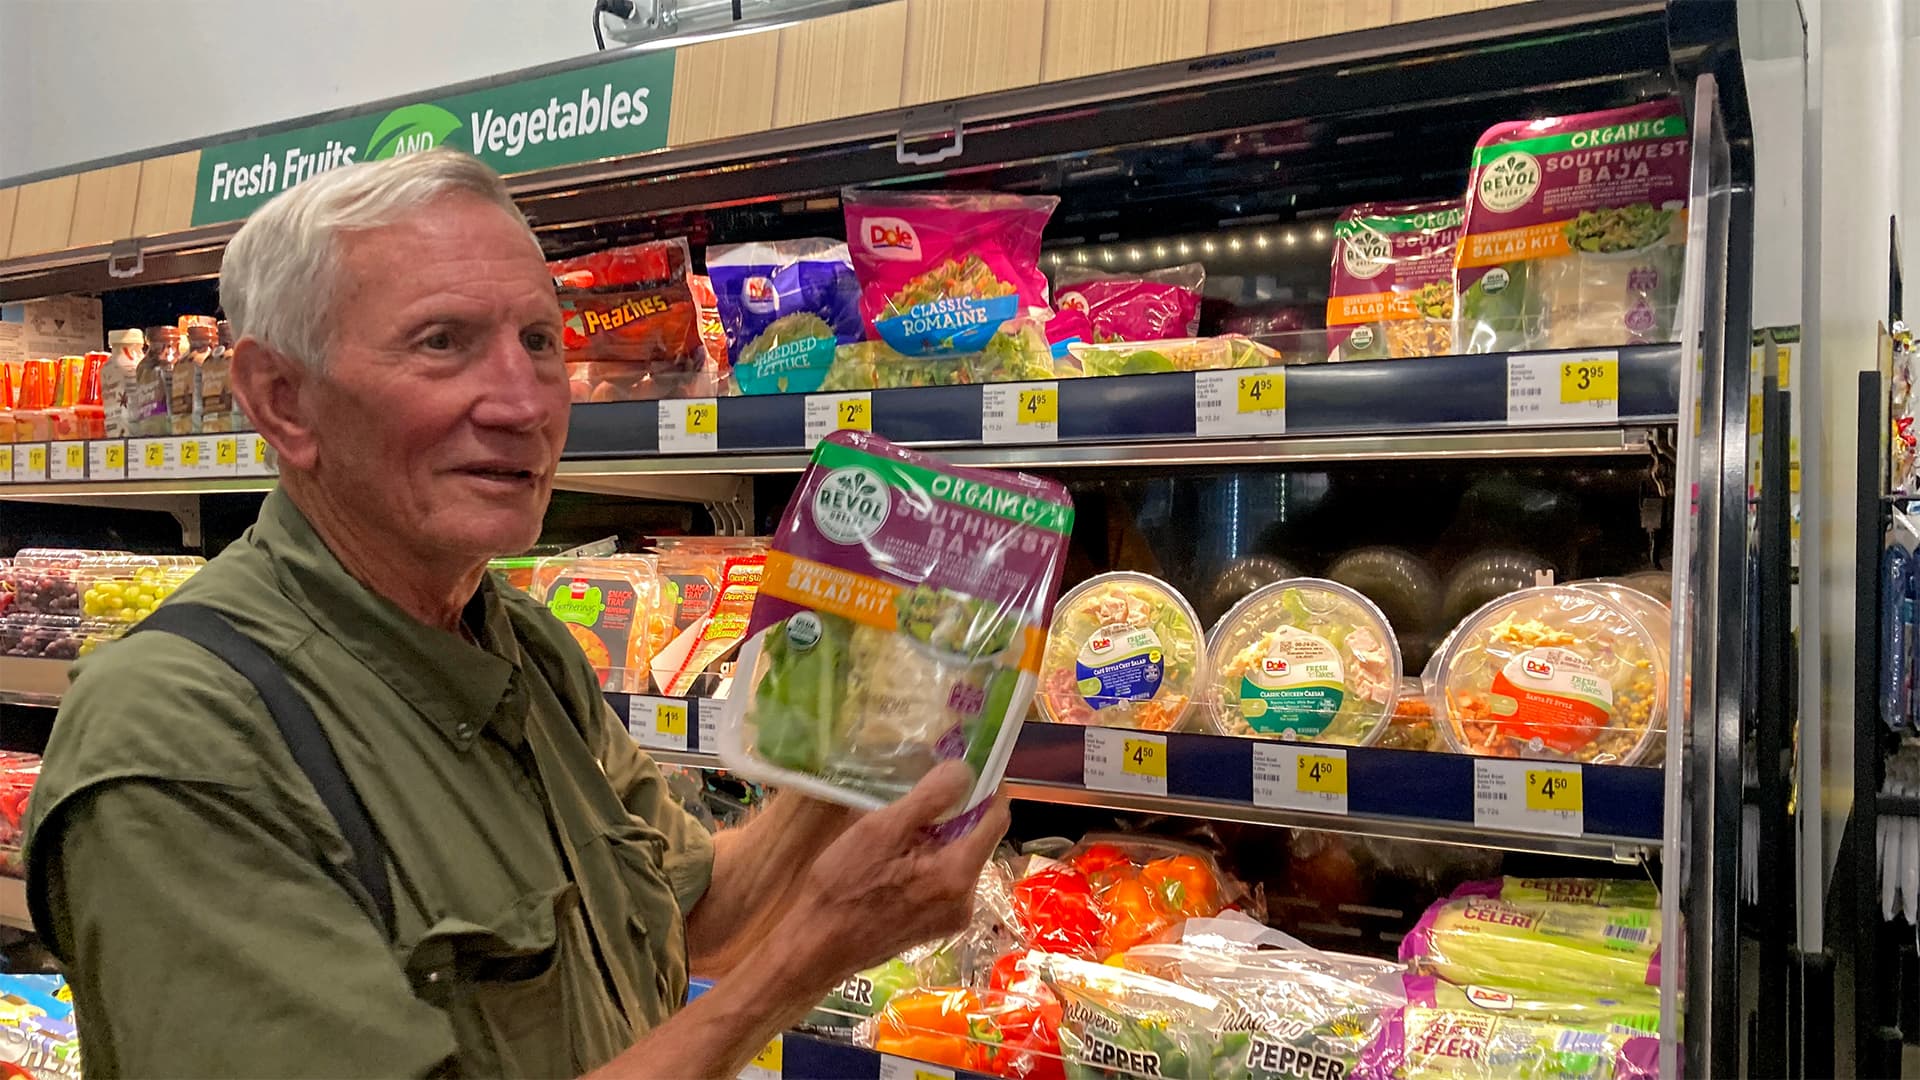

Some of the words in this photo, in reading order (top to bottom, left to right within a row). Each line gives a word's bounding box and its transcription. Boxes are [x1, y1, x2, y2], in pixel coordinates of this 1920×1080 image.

[210, 153, 275, 202] Fresh
[281, 141, 356, 190] Fruits
[394, 131, 434, 154] AND
[471, 83, 650, 156] Vegetables
[1571, 119, 1665, 148] ORGANIC
[1545, 140, 1688, 173] SOUTHWEST
[1483, 170, 1536, 193] REVOL
[1578, 161, 1649, 184] BAJA
[870, 225, 913, 245] Dole
[1473, 238, 1526, 259] SALAD
[1530, 233, 1559, 249] KIT
[584, 295, 669, 334] Peaches
[902, 307, 988, 337] ROMAINE
[910, 296, 972, 319] CLASSIC
[1343, 302, 1384, 317] SALAD
[752, 336, 817, 368] SHREDDED
[757, 353, 811, 378] LETTUCE
[820, 488, 881, 521] REVOL
[931, 473, 1037, 521] ORGANIC
[786, 571, 853, 604] SALAD
[855, 591, 889, 615] KIT
[1265, 660, 1287, 671] Dole
[1526, 659, 1551, 673] Dole
[1463, 908, 1533, 930] CELERI
[1081, 1034, 1160, 1077] PEPPER
[1247, 1037, 1344, 1080] PEPPER
